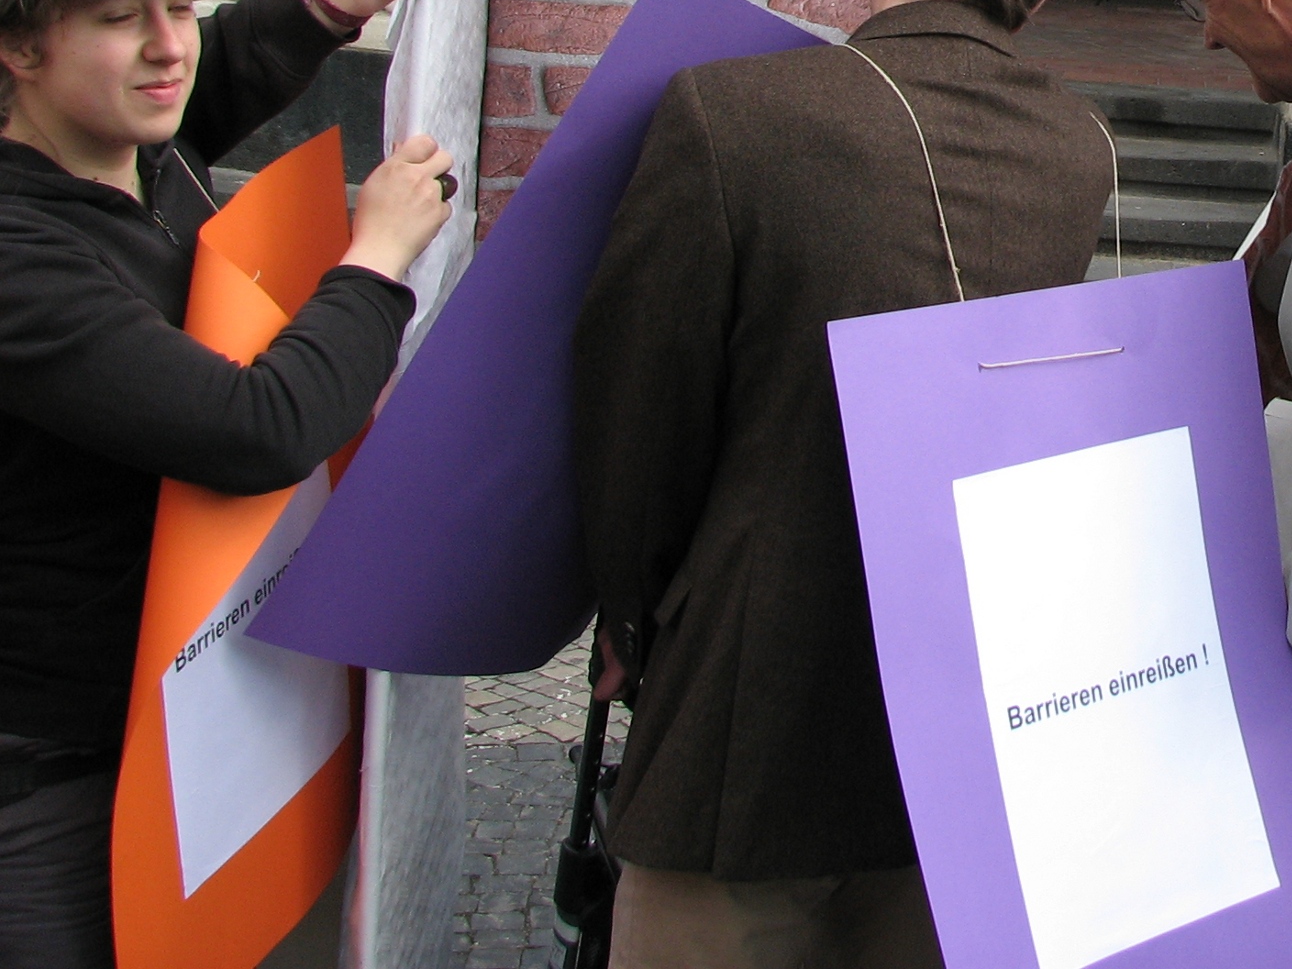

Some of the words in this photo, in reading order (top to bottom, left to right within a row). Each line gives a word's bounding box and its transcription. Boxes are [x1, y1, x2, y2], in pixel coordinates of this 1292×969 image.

[175, 599, 250, 673] Barrieren
[1007, 684, 1103, 730] Barrieren
[1109, 654, 1197, 696] einreißen
